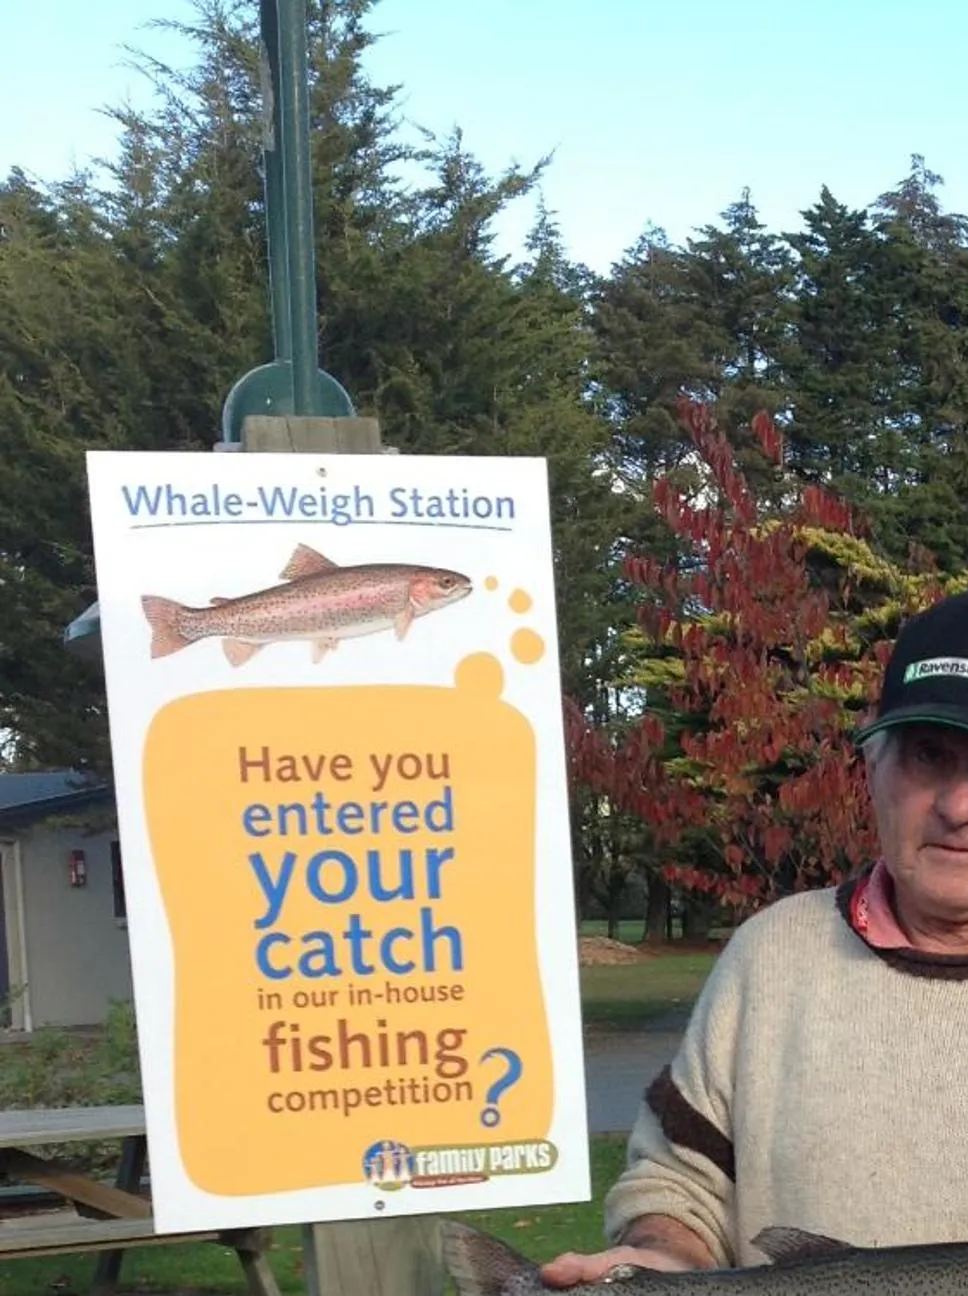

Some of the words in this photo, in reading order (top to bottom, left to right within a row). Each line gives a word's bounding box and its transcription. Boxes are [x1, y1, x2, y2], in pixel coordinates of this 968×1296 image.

[122, 485, 374, 525] Whale-Weigh
[391, 488, 516, 519] Station
[238, 746, 353, 783] Have
[369, 751, 450, 791] you
[242, 786, 455, 837] entered
[248, 847, 455, 929] your
[254, 907, 464, 980] catch
[257, 988, 282, 1010] in
[293, 987, 339, 1008] our
[348, 982, 465, 1005] in-house
[262, 1019, 469, 1078] fishing
[415, 1147, 486, 1176] family
[489, 1144, 551, 1170] parks
